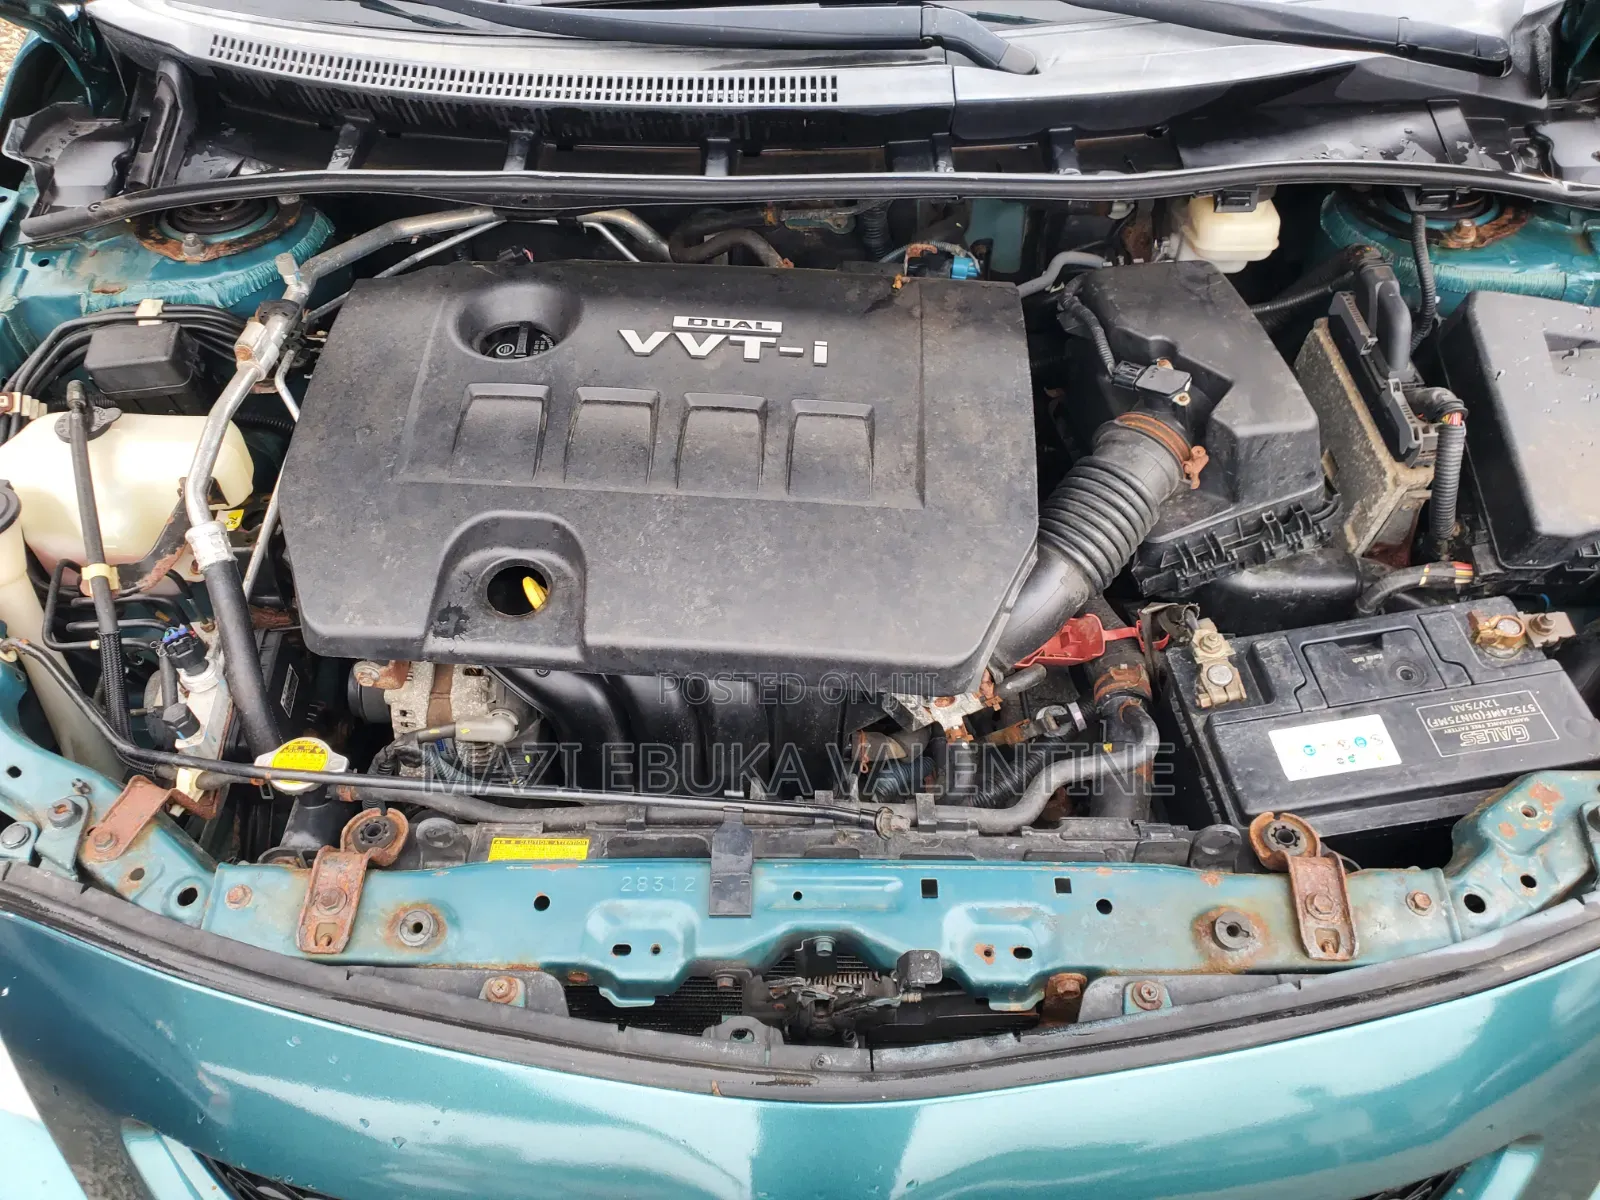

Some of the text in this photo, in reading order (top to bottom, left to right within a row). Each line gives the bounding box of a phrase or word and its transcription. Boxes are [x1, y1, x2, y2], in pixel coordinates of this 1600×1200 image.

[687, 317, 773, 331] DUAL
[617, 329, 828, 367] VVT-i
[1450, 698, 1500, 713] 12V75Ah
[1443, 725, 1470, 734] BATTERY
[1460, 724, 1530, 747] GALES
[619, 875, 697, 893] 28312
